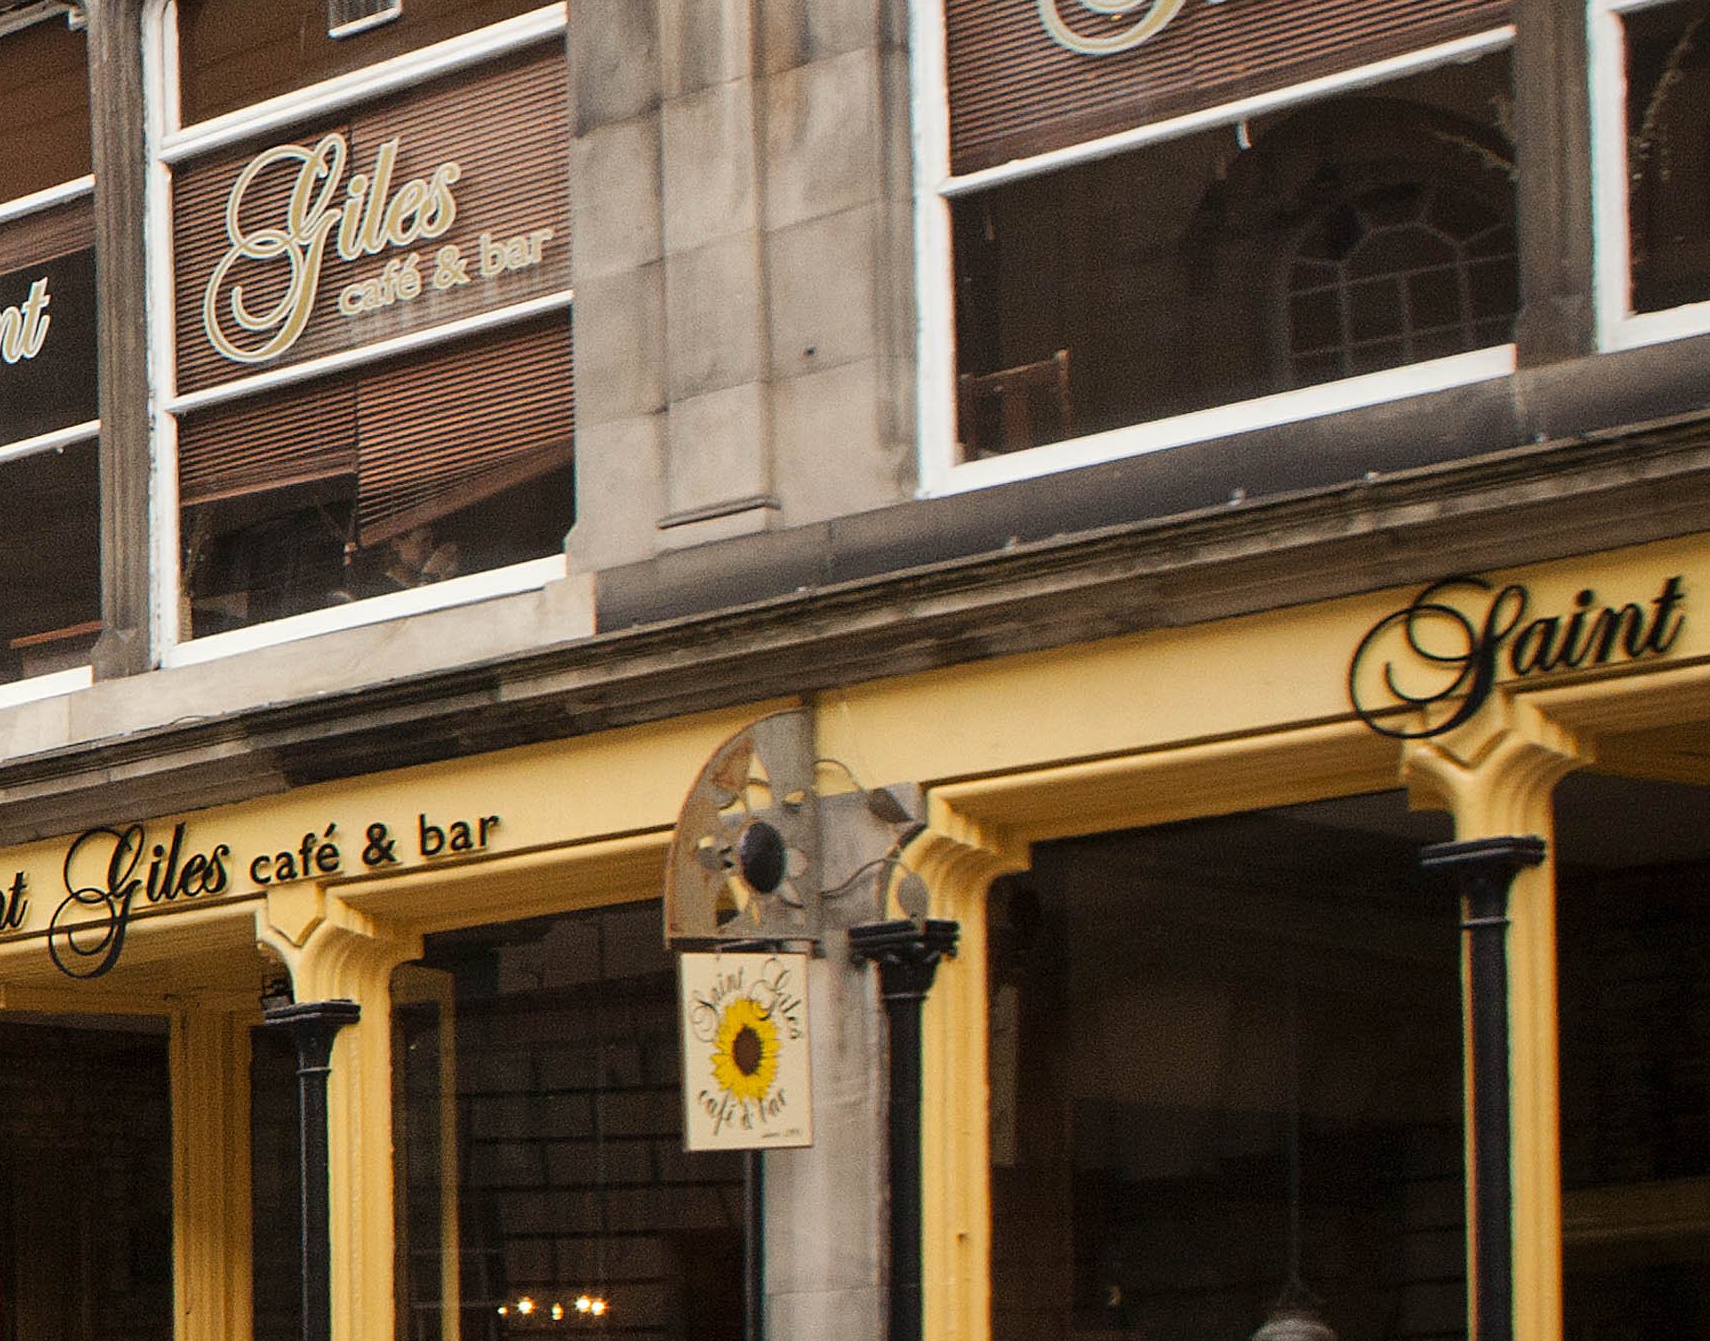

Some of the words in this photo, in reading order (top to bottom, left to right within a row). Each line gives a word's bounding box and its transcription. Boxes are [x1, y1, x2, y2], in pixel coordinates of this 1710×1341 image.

[204, 131, 462, 364] Giles
[338, 250, 421, 317] café
[431, 242, 470, 288] &
[478, 225, 554, 279] bar
[1349, 575, 1686, 739] Saint
[47, 821, 232, 980] Giles
[248, 823, 340, 886] café
[360, 822, 398, 868] &
[416, 811, 501, 858] bar
